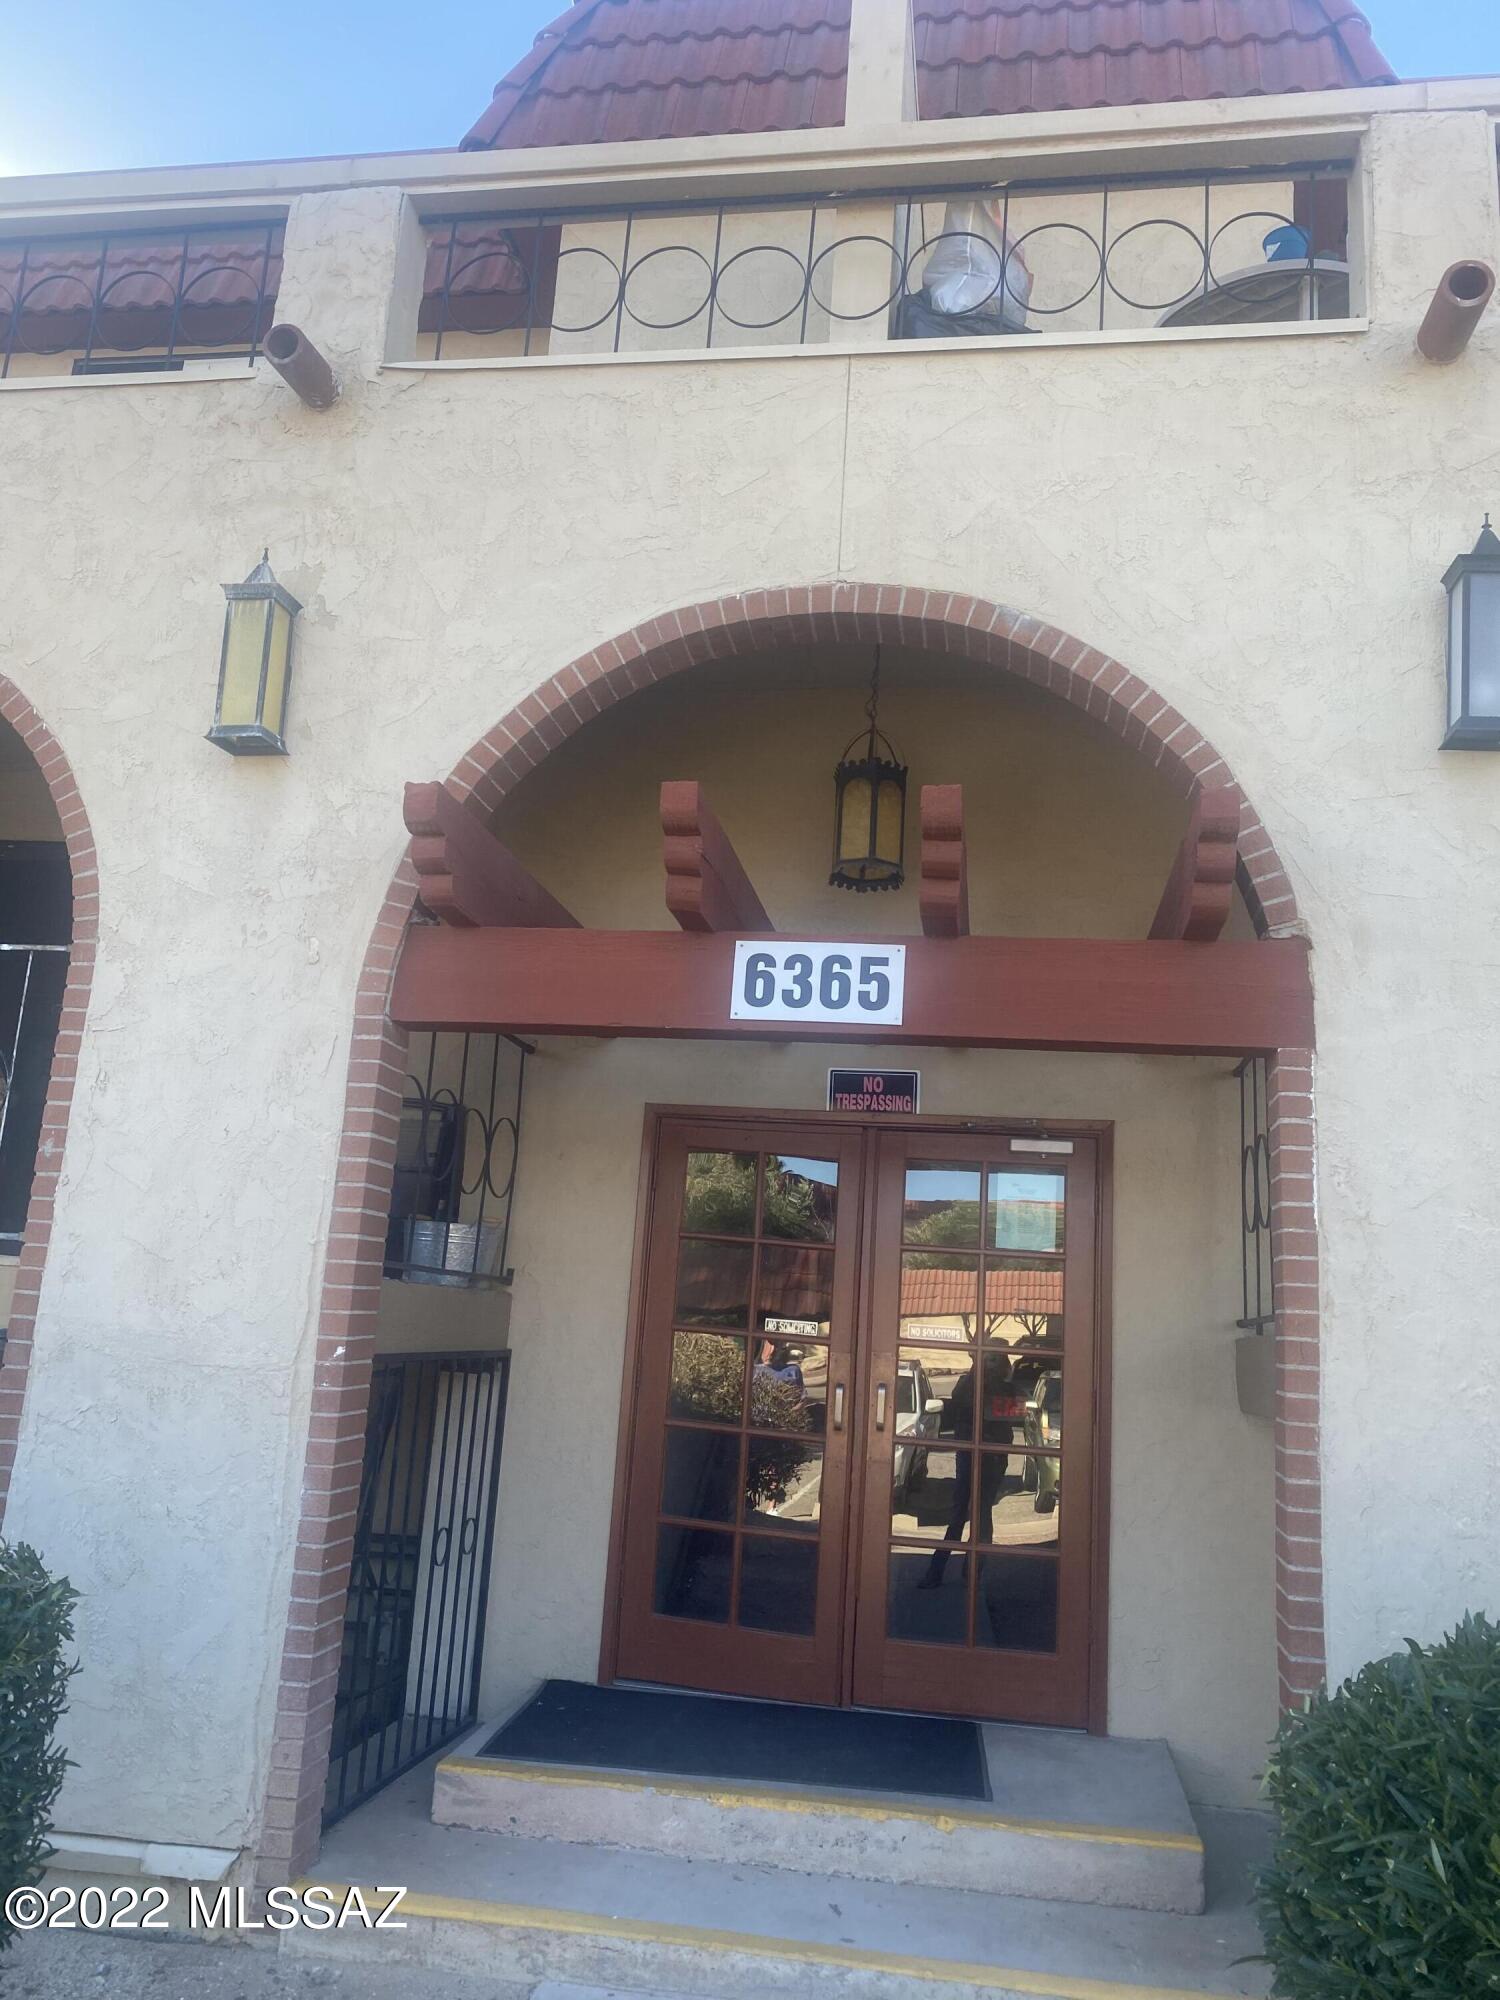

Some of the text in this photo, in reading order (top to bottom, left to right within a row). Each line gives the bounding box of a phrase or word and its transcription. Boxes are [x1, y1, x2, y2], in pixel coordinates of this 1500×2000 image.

[743, 952, 891, 1012] 6365
[863, 1076, 884, 1093] NO
[835, 1093, 912, 1112] TRESPASSING
[767, 1320, 816, 1335] NO SOLICITING
[910, 1327, 961, 1340] NO SOLICITORS
